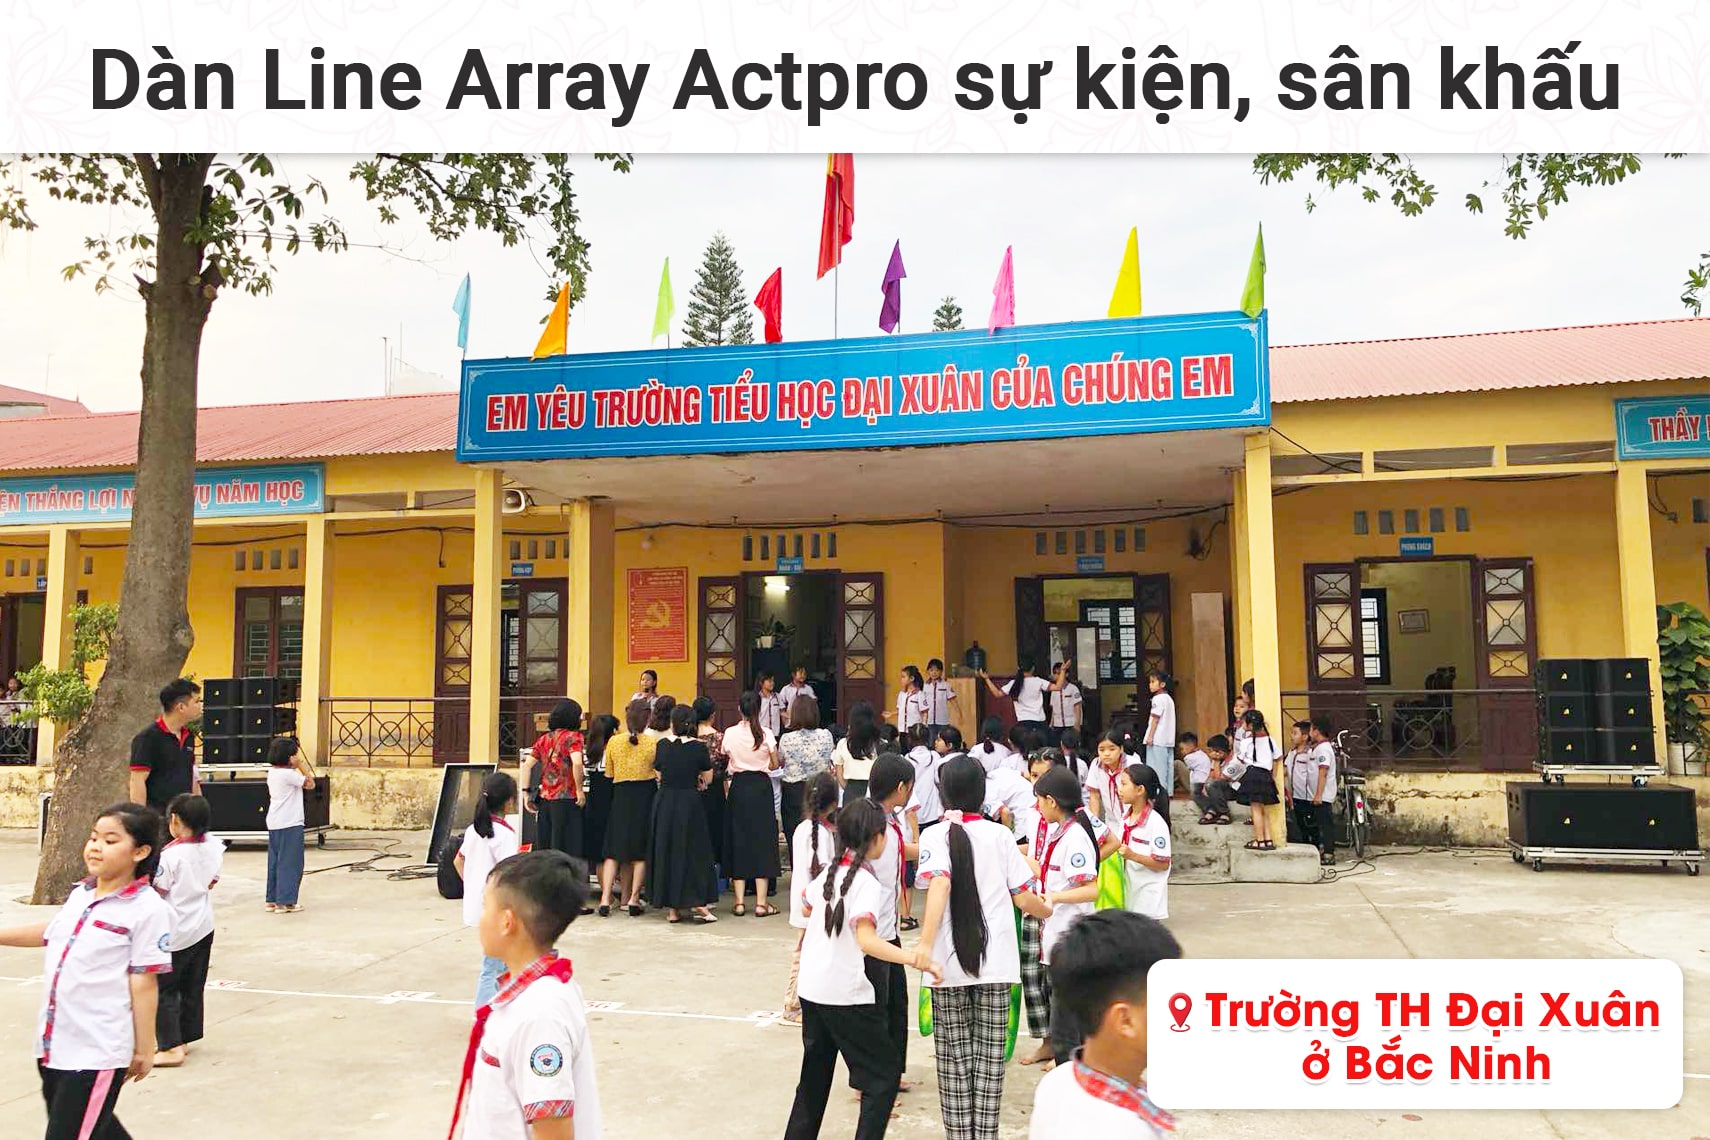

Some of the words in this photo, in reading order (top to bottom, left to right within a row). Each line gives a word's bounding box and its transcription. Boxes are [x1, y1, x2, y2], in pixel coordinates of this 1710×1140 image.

[486, 393, 529, 432] EM
[535, 384, 586, 430] YÊU
[594, 378, 702, 428] TRƯỜNG
[709, 368, 769, 424] TIỂU
[777, 378, 835, 428] HỌC
[842, 376, 892, 424] ĐẠI
[899, 364, 983, 417] XUÂN
[991, 354, 1056, 409] CỦA
[1063, 352, 1173, 405] CHÚNG
[1181, 353, 1234, 400] EM
[1648, 406, 1701, 442] THẦY
[26, 485, 84, 512] THẮNG
[88, 488, 117, 514] LỢI
[216, 478, 260, 504] NĂM
[265, 480, 305, 507] HỌC
